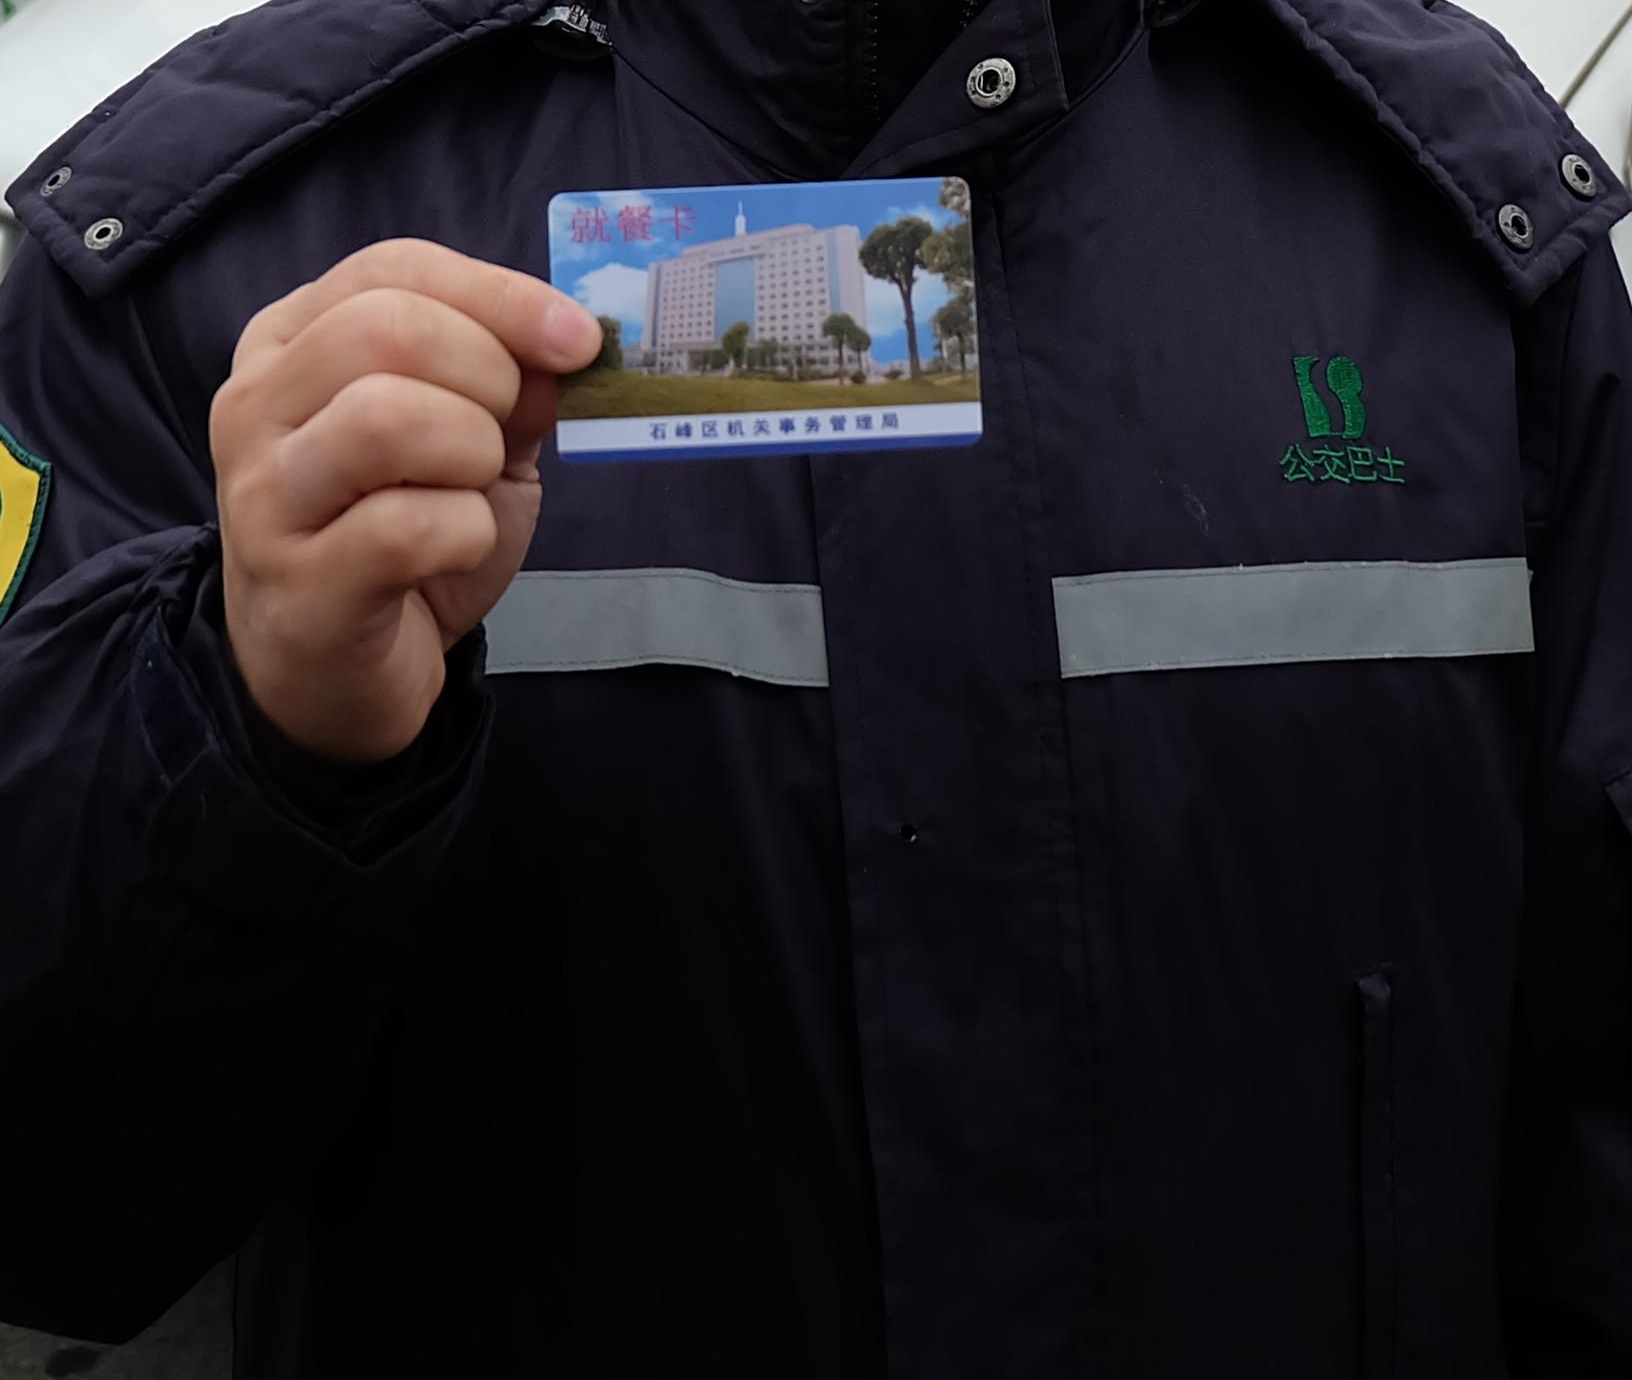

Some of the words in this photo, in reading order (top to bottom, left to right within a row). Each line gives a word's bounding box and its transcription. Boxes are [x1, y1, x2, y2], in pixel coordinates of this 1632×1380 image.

[571, 204, 698, 244] 就餐卡
[649, 412, 900, 441] 石峰区机关事务管理局
[1279, 443, 1406, 485] 公交巴士
